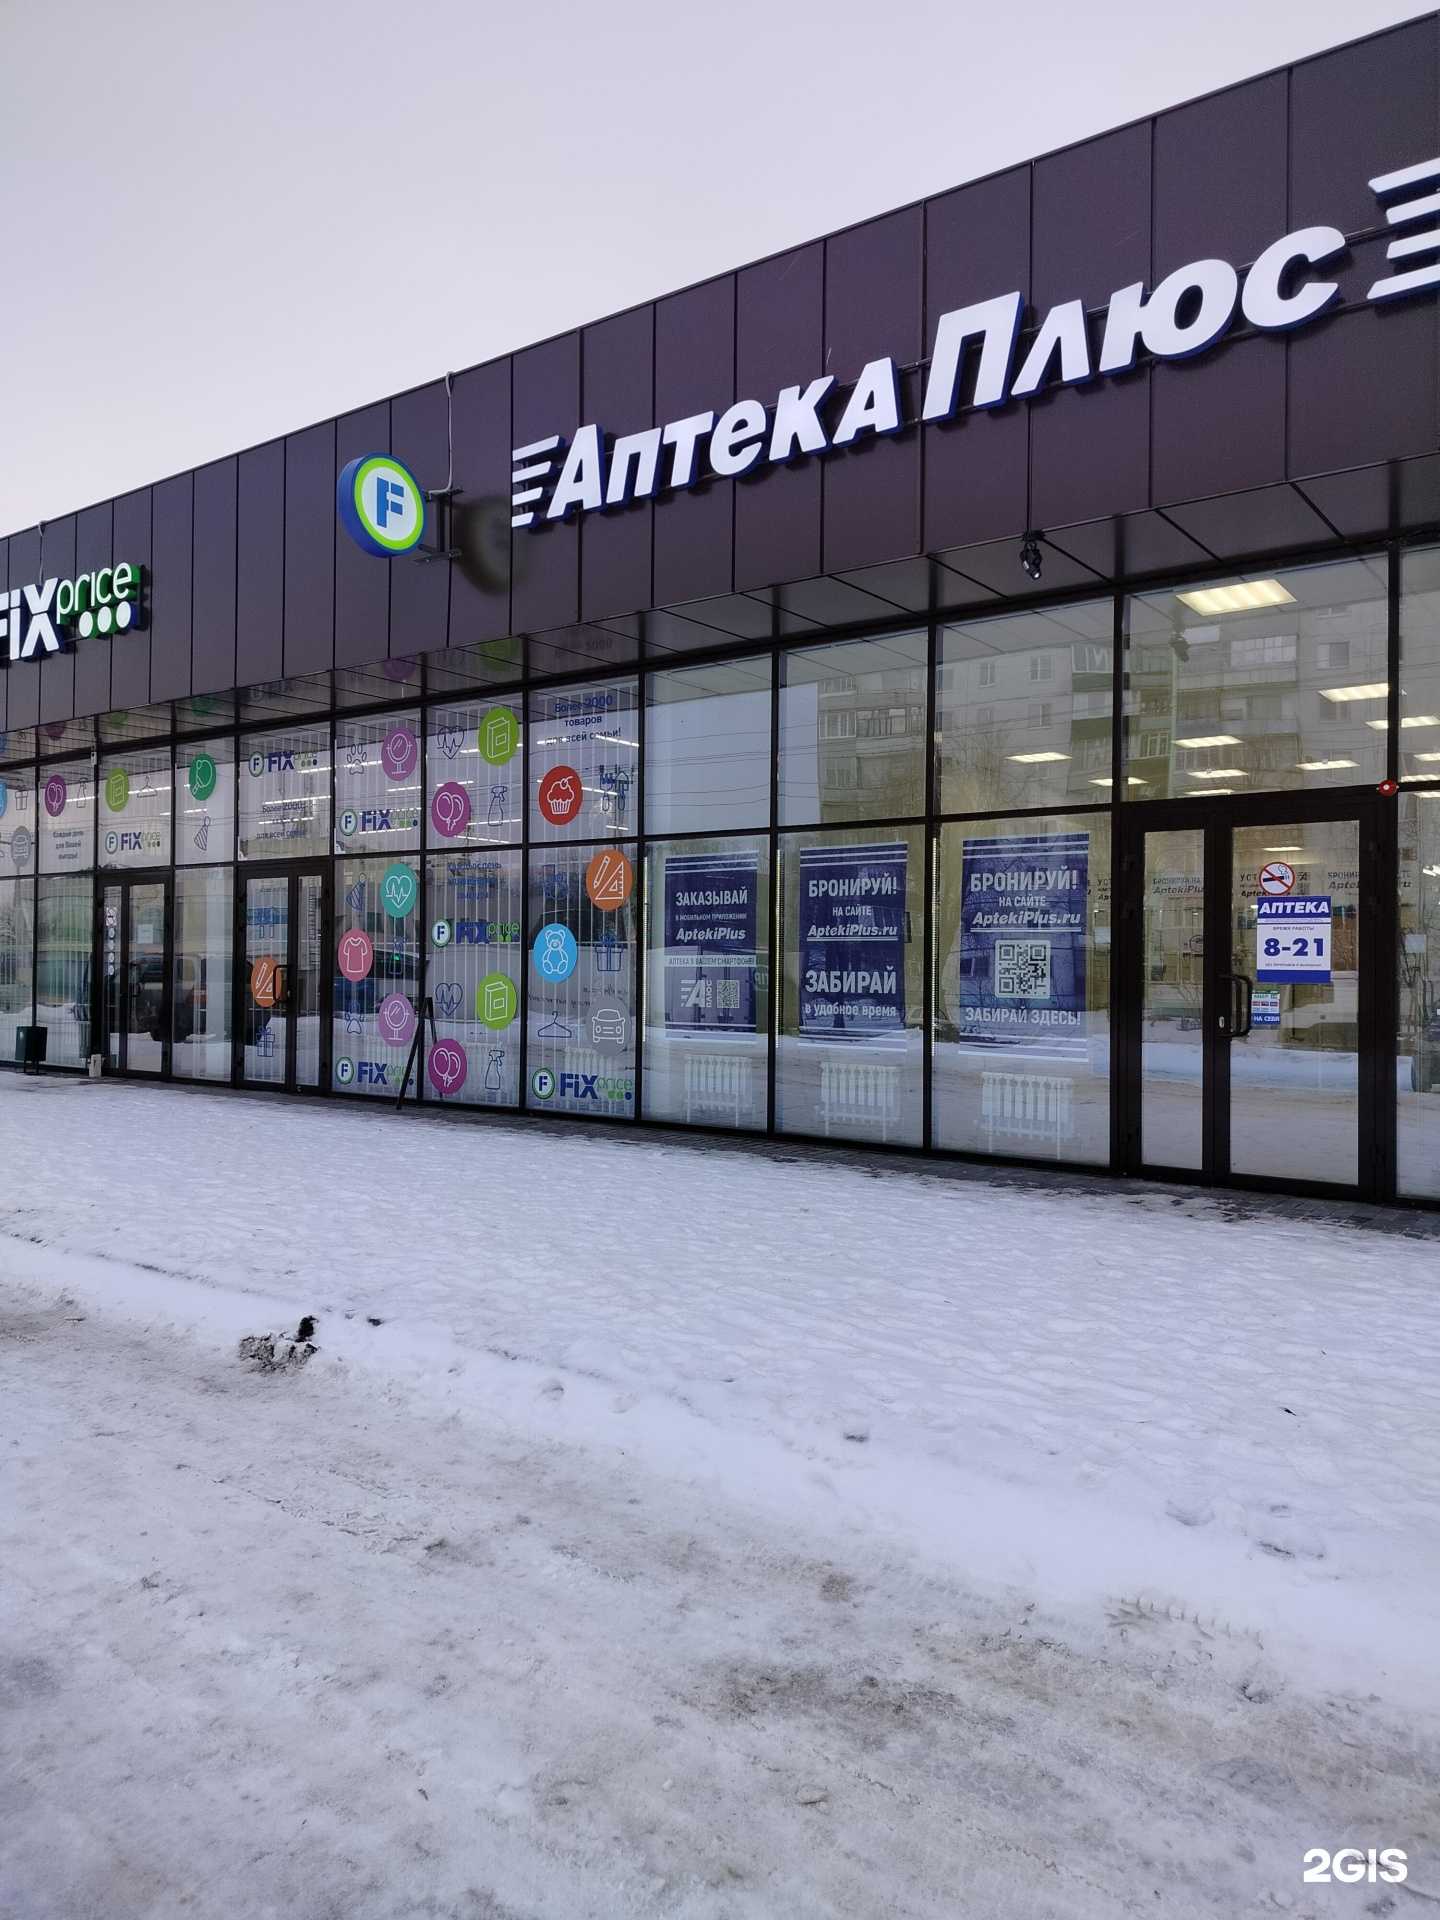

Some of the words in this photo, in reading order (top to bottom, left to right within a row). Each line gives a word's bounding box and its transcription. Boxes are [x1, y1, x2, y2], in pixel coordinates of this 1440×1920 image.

[376, 477, 405, 529] F
[56, 562, 133, 625] price
[564, 715, 603, 727] товаров
[808, 873, 897, 897] БРОНИРУЙ!
[970, 865, 1077, 892] БРОНИРУЙ!
[675, 886, 748, 906] ЗАКАЗЫВАЙ
[998, 897, 1012, 907] НА
[1014, 893, 1046, 907] САЙТЕ
[832, 906, 843, 917] НА
[845, 903, 872, 916] САЙТЕ
[1258, 901, 1330, 914] АПТЕКА
[972, 911, 1081, 926] AptekiPlus.ru
[675, 927, 747, 942] AptekiPlus
[808, 923, 898, 938] AptekiPlus.ru
[1264, 937, 1324, 957] 8-21
[805, 966, 896, 994] ЗАБИРАЙ
[814, 1002, 859, 1018] удобное
[862, 1005, 897, 1018] время
[965, 1006, 1028, 1024] ЗАБИРАЙ
[1030, 1008, 1081, 1026] ЗДЕСЬ!
